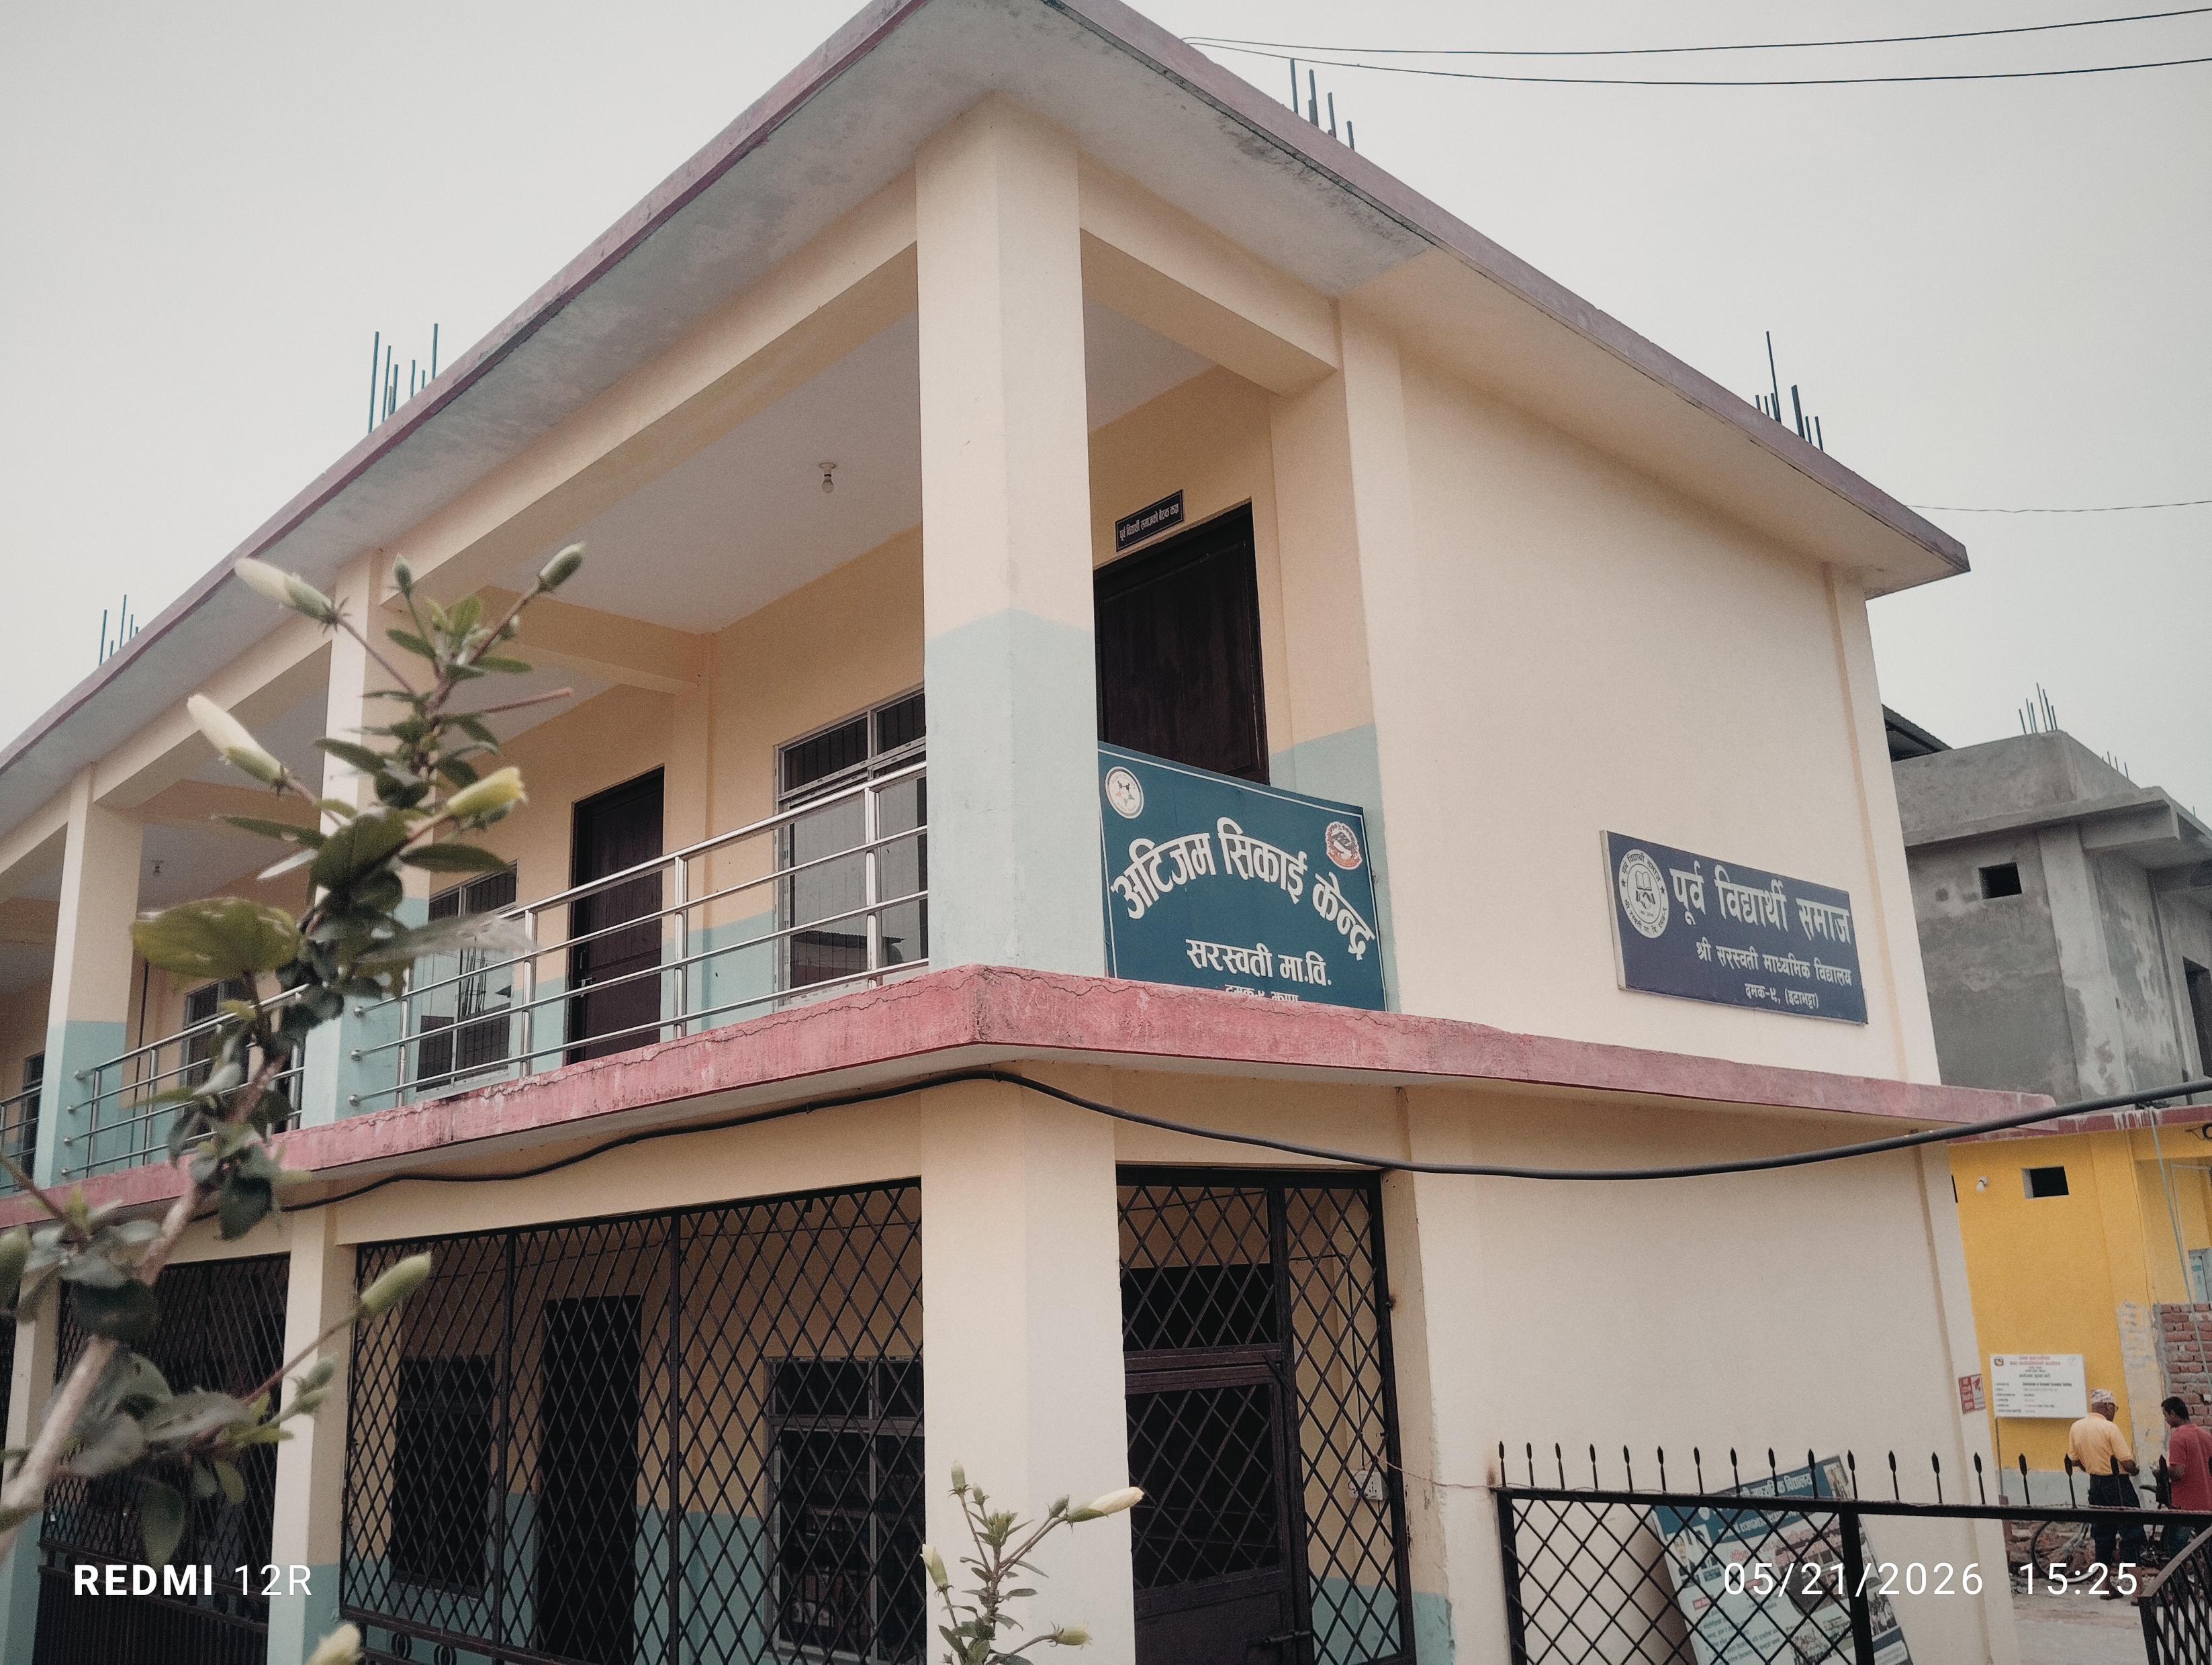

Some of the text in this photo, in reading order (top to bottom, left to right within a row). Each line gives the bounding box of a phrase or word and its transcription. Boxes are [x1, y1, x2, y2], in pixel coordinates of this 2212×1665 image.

[1110, 817, 1375, 960] अटिजम सिकाई केन्द्र
[1669, 860, 1851, 945] पूर्व विद्यार्थी समाज
[1186, 939, 1332, 986] सरस्वती मा.वि.
[1696, 937, 1852, 986] श्री सरस्वती माध्यमिक विद्यालय
